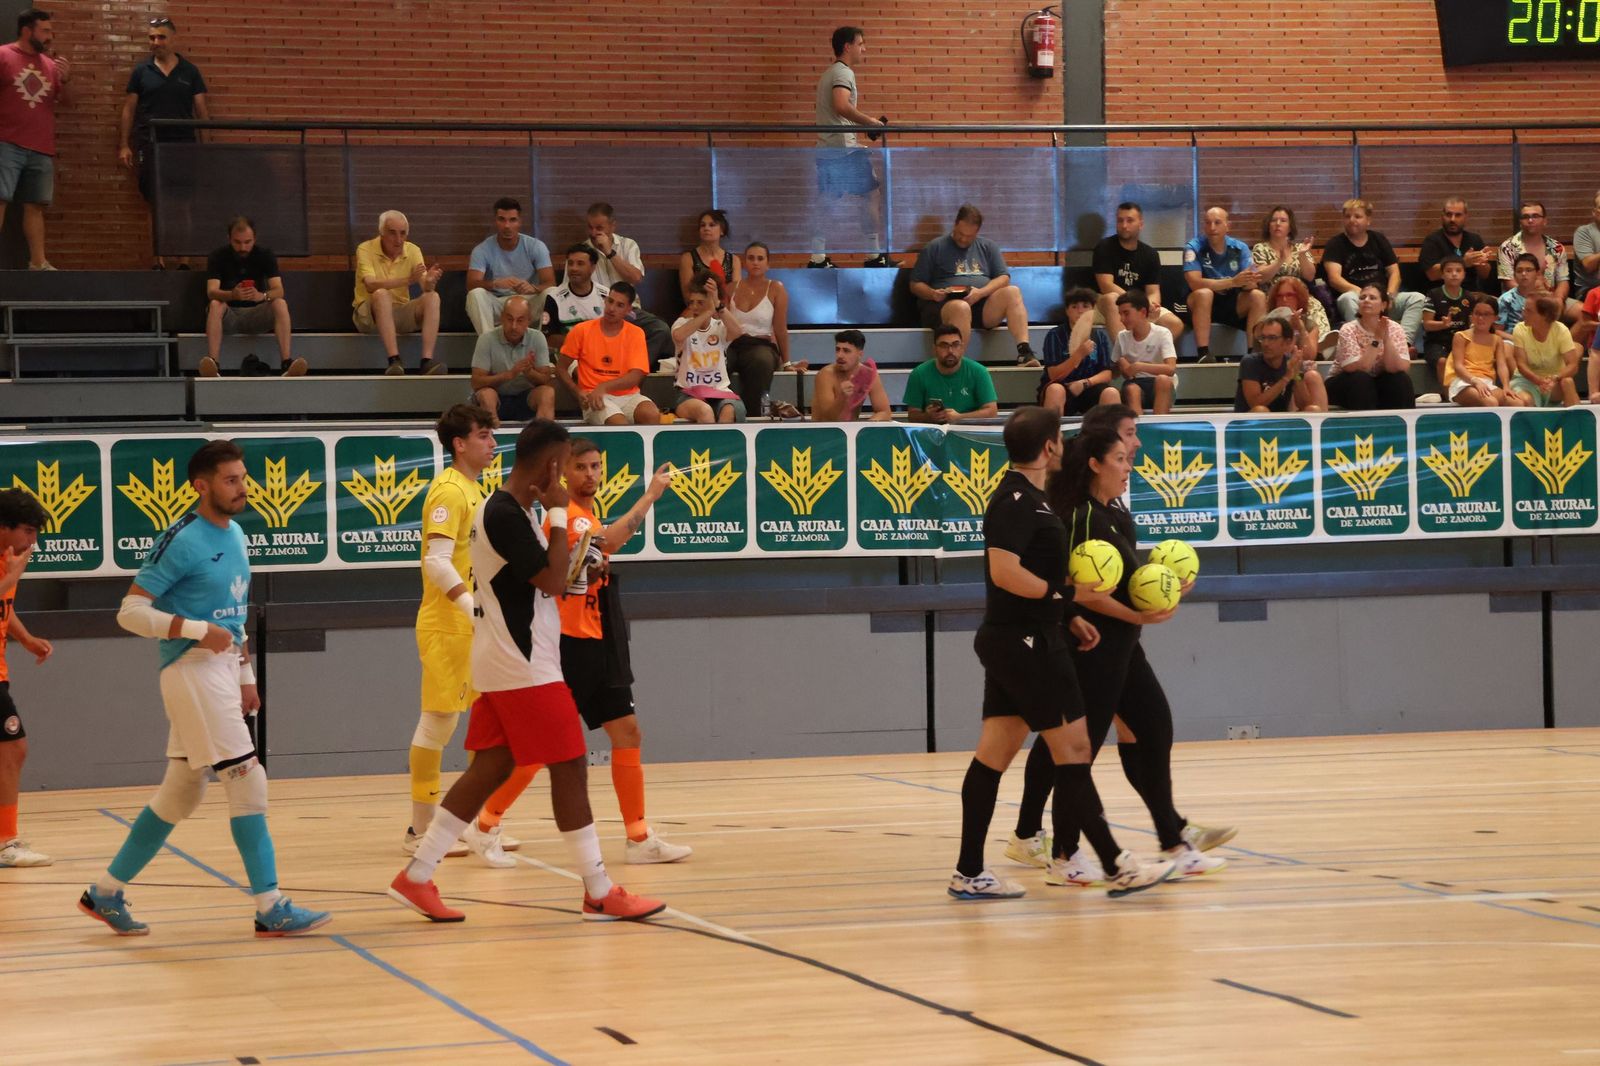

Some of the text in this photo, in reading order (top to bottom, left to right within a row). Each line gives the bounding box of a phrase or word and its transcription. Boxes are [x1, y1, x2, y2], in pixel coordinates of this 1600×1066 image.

[1421, 501, 1500, 515] CAJA RURAL
[1516, 499, 1595, 511] CAJA RURAL
[1231, 508, 1311, 522] CAJA RURAL
[1326, 504, 1406, 519] CAJA RURAL
[1530, 512, 1581, 521] DE ZAMORA
[1135, 512, 1216, 526] CAJA RURAL
[1341, 518, 1393, 528] DE ZAMORA
[1436, 515, 1487, 524] DE ZAMORA
[658, 521, 744, 535] CAJA RURAL
[760, 520, 845, 534] CAJA RURAL
[860, 518, 943, 532] CAJA RURAL
[942, 520, 974, 533] CAJA
[1149, 525, 1202, 535] DE ZAMORA
[1245, 521, 1298, 531] DE ZAMORA
[272, 532, 324, 545] RURAL
[341, 529, 422, 544] CAJA RURA
[673, 535, 729, 544] DE ZAMORA
[775, 533, 830, 542] DE ZAMORA
[875, 532, 929, 541] DE ZAMORA
[954, 534, 967, 542] DE
[45, 538, 99, 551] RURAL
[357, 544, 416, 553] DE ZAMORA
[248, 547, 308, 557] DE ZAMORA
[37, 554, 82, 562] ZAMORA
